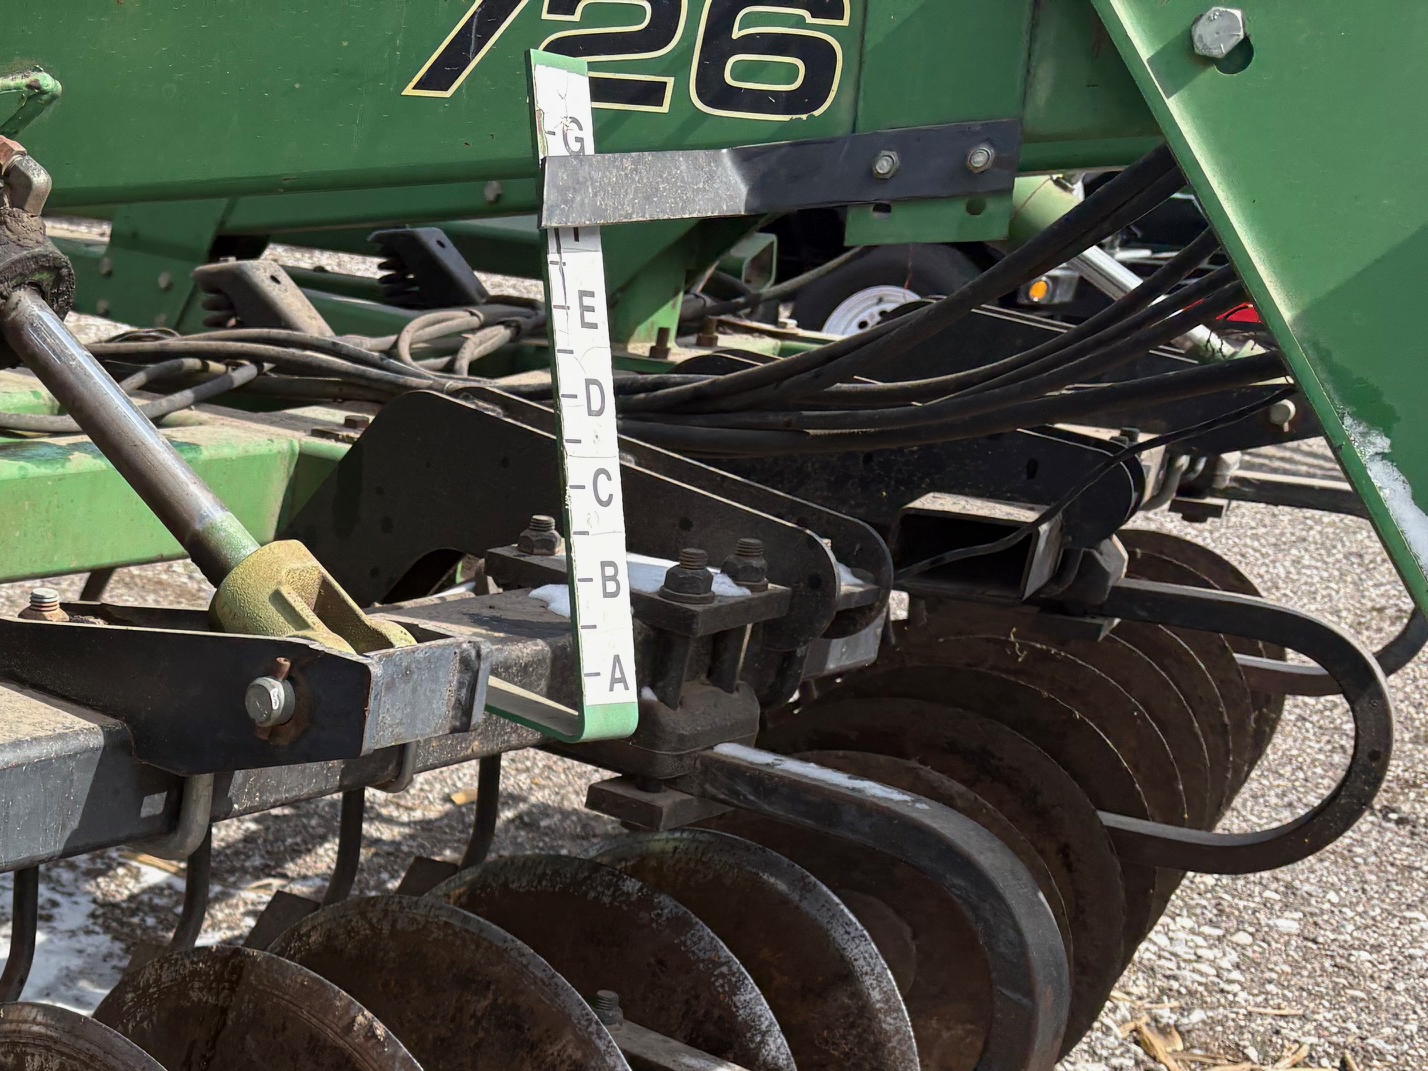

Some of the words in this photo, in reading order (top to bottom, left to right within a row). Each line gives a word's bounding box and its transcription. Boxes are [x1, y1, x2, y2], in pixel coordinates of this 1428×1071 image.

[562, 116, 585, 155] G
[578, 290, 598, 329] E
[585, 379, 605, 416] D
[593, 468, 613, 507] C
[601, 561, 621, 598] B
[609, 654, 629, 692] A
